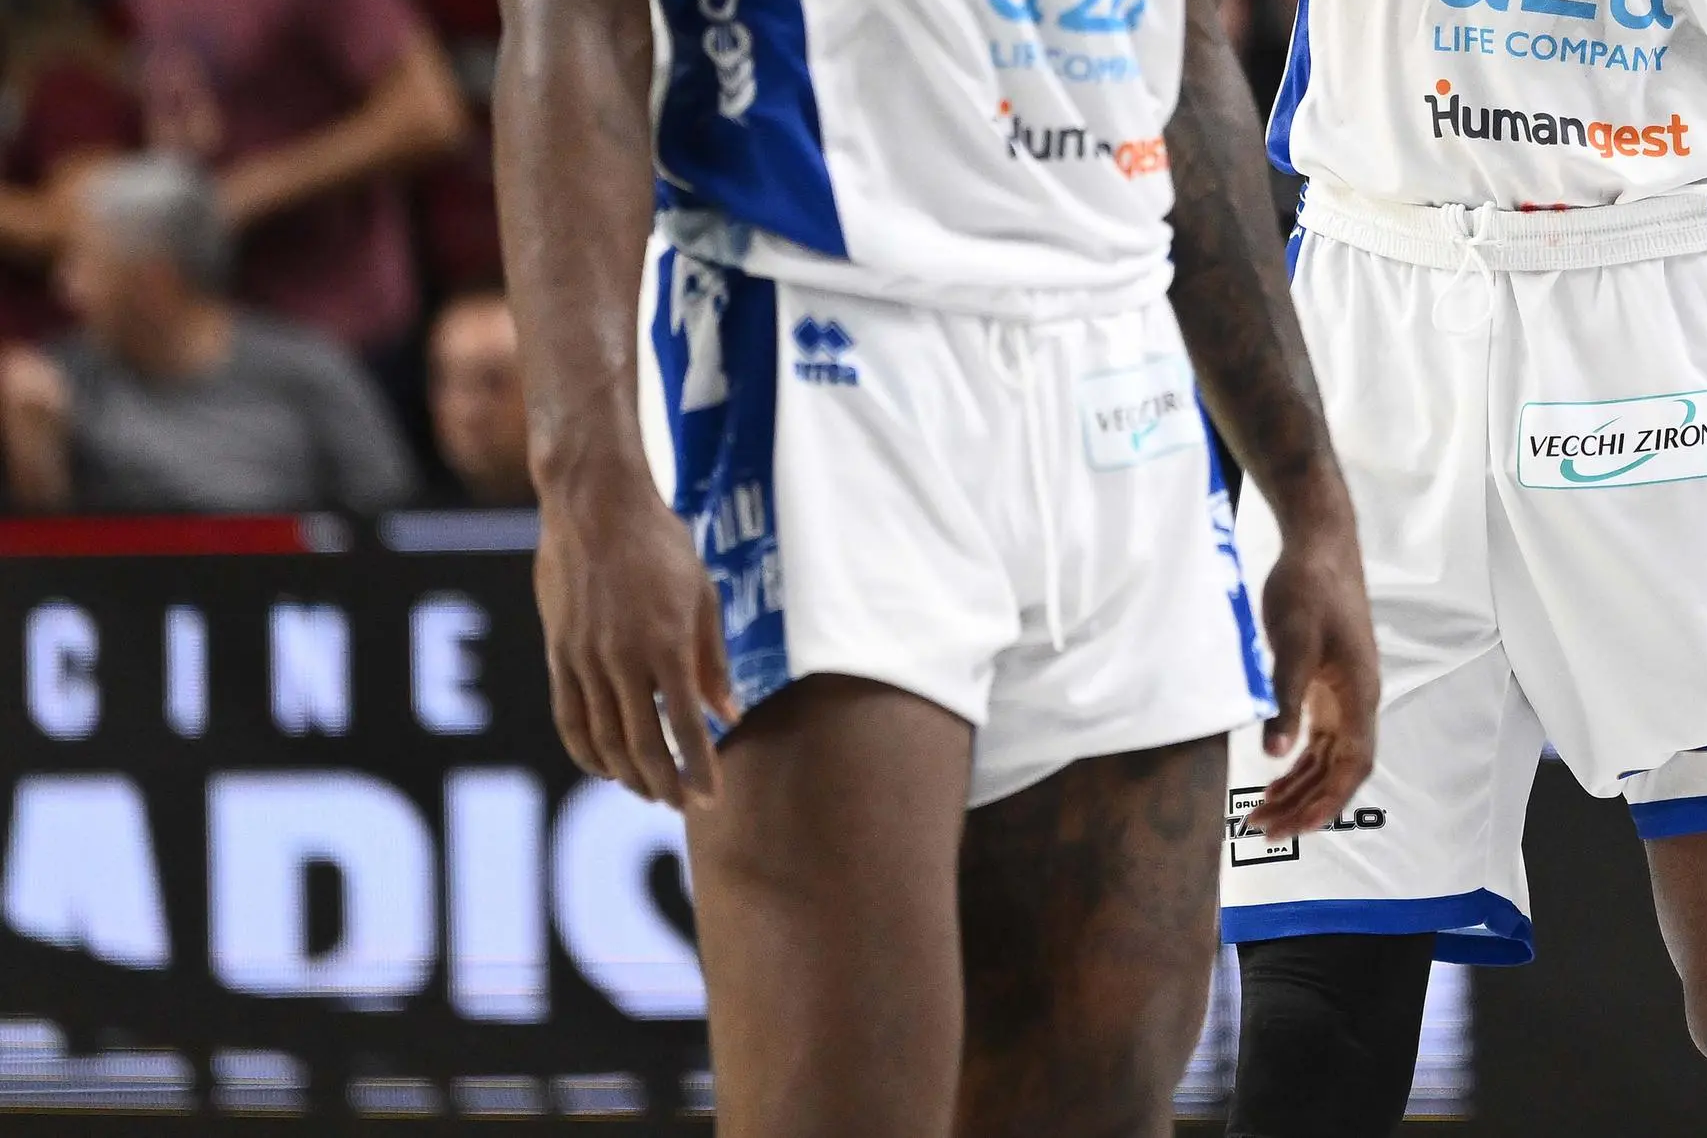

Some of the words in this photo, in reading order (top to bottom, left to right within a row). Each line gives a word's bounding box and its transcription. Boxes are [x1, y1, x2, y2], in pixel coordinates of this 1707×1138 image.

[1434, 25, 1493, 55] LIFE
[1505, 31, 1668, 72] COMPANY
[1424, 78, 1691, 158] Humangest
[1528, 431, 1625, 459] VECCHI
[1267, 846, 1288, 854] SPA
